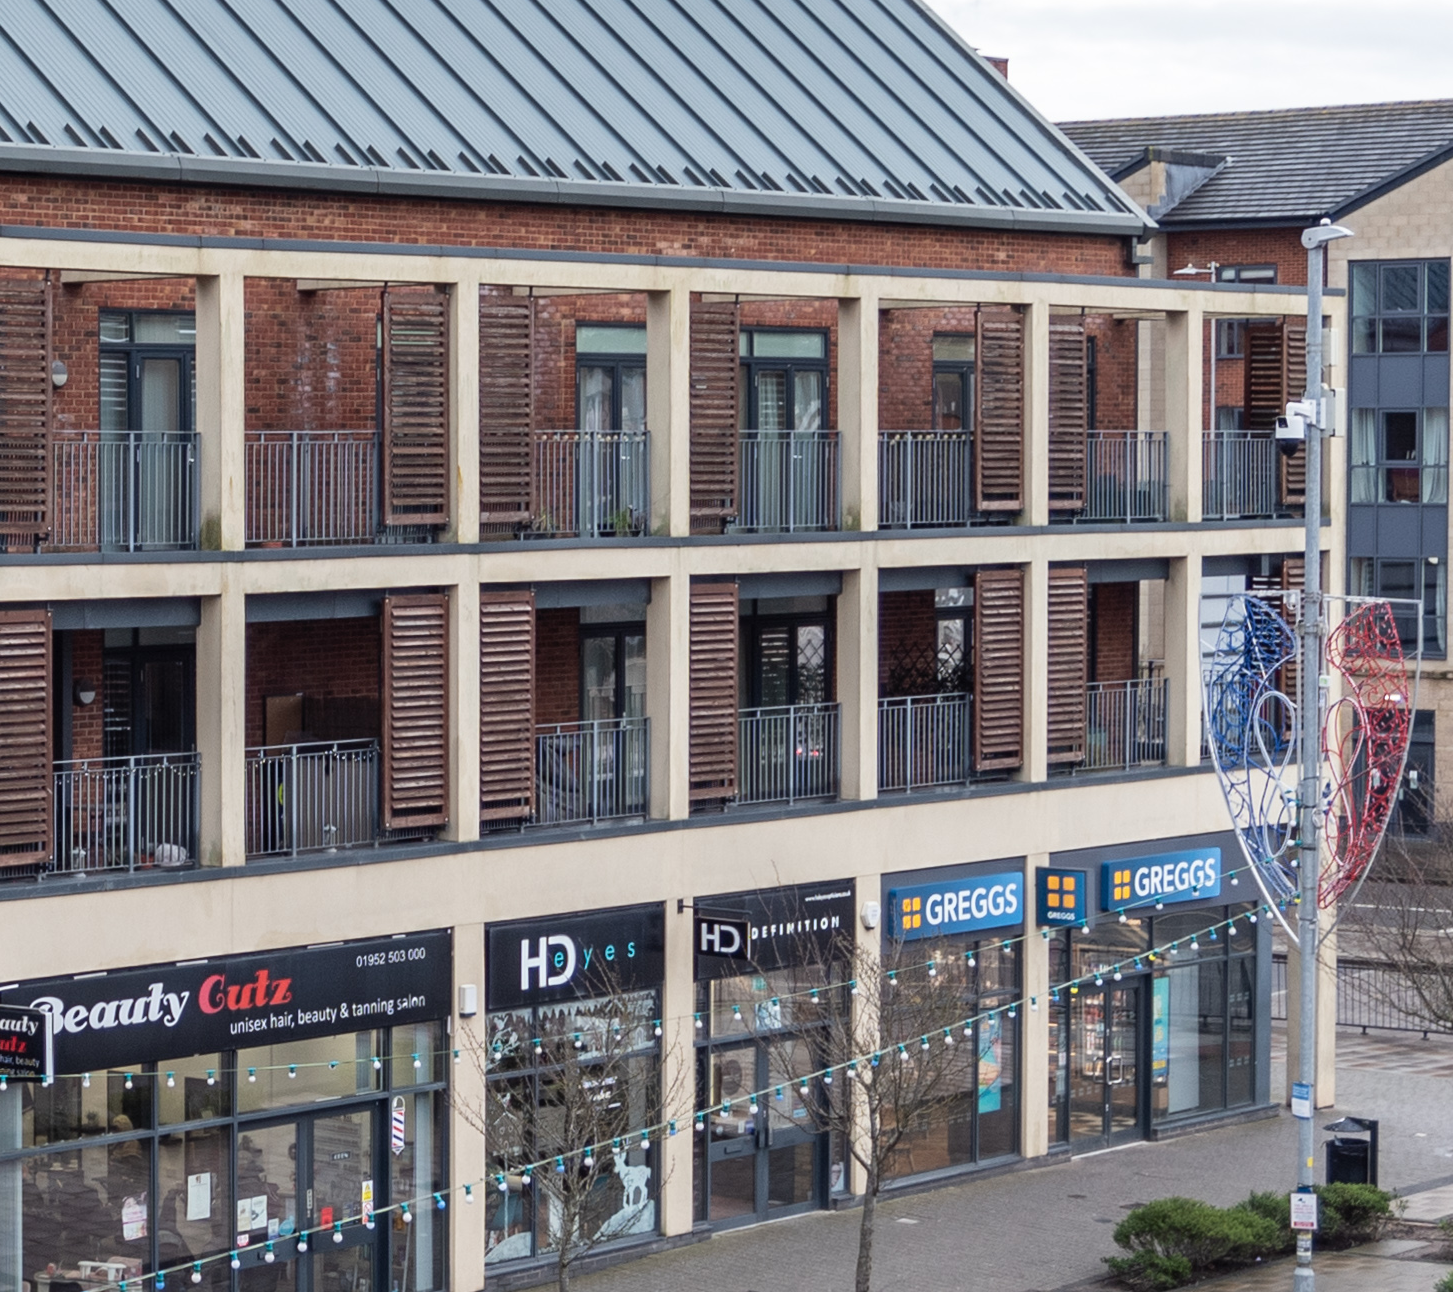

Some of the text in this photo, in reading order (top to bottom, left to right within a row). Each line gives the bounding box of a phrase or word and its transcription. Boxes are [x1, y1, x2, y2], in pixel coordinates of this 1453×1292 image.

[1134, 858, 1216, 896] GREGGS
[926, 883, 1018, 925] GREGGS
[1047, 911, 1075, 921] GREGGS
[701, 916, 840, 953] HD DEFINITION
[356, 947, 426, 967] 01952 503 000
[521, 934, 576, 990] HD
[30, 969, 292, 1036] Beauty Cutz
[230, 994, 425, 1035] unisex hair, beauty & tanning salon
[0, 1054, 14, 1065] hair,
[15, 1056, 40, 1068] beauty
